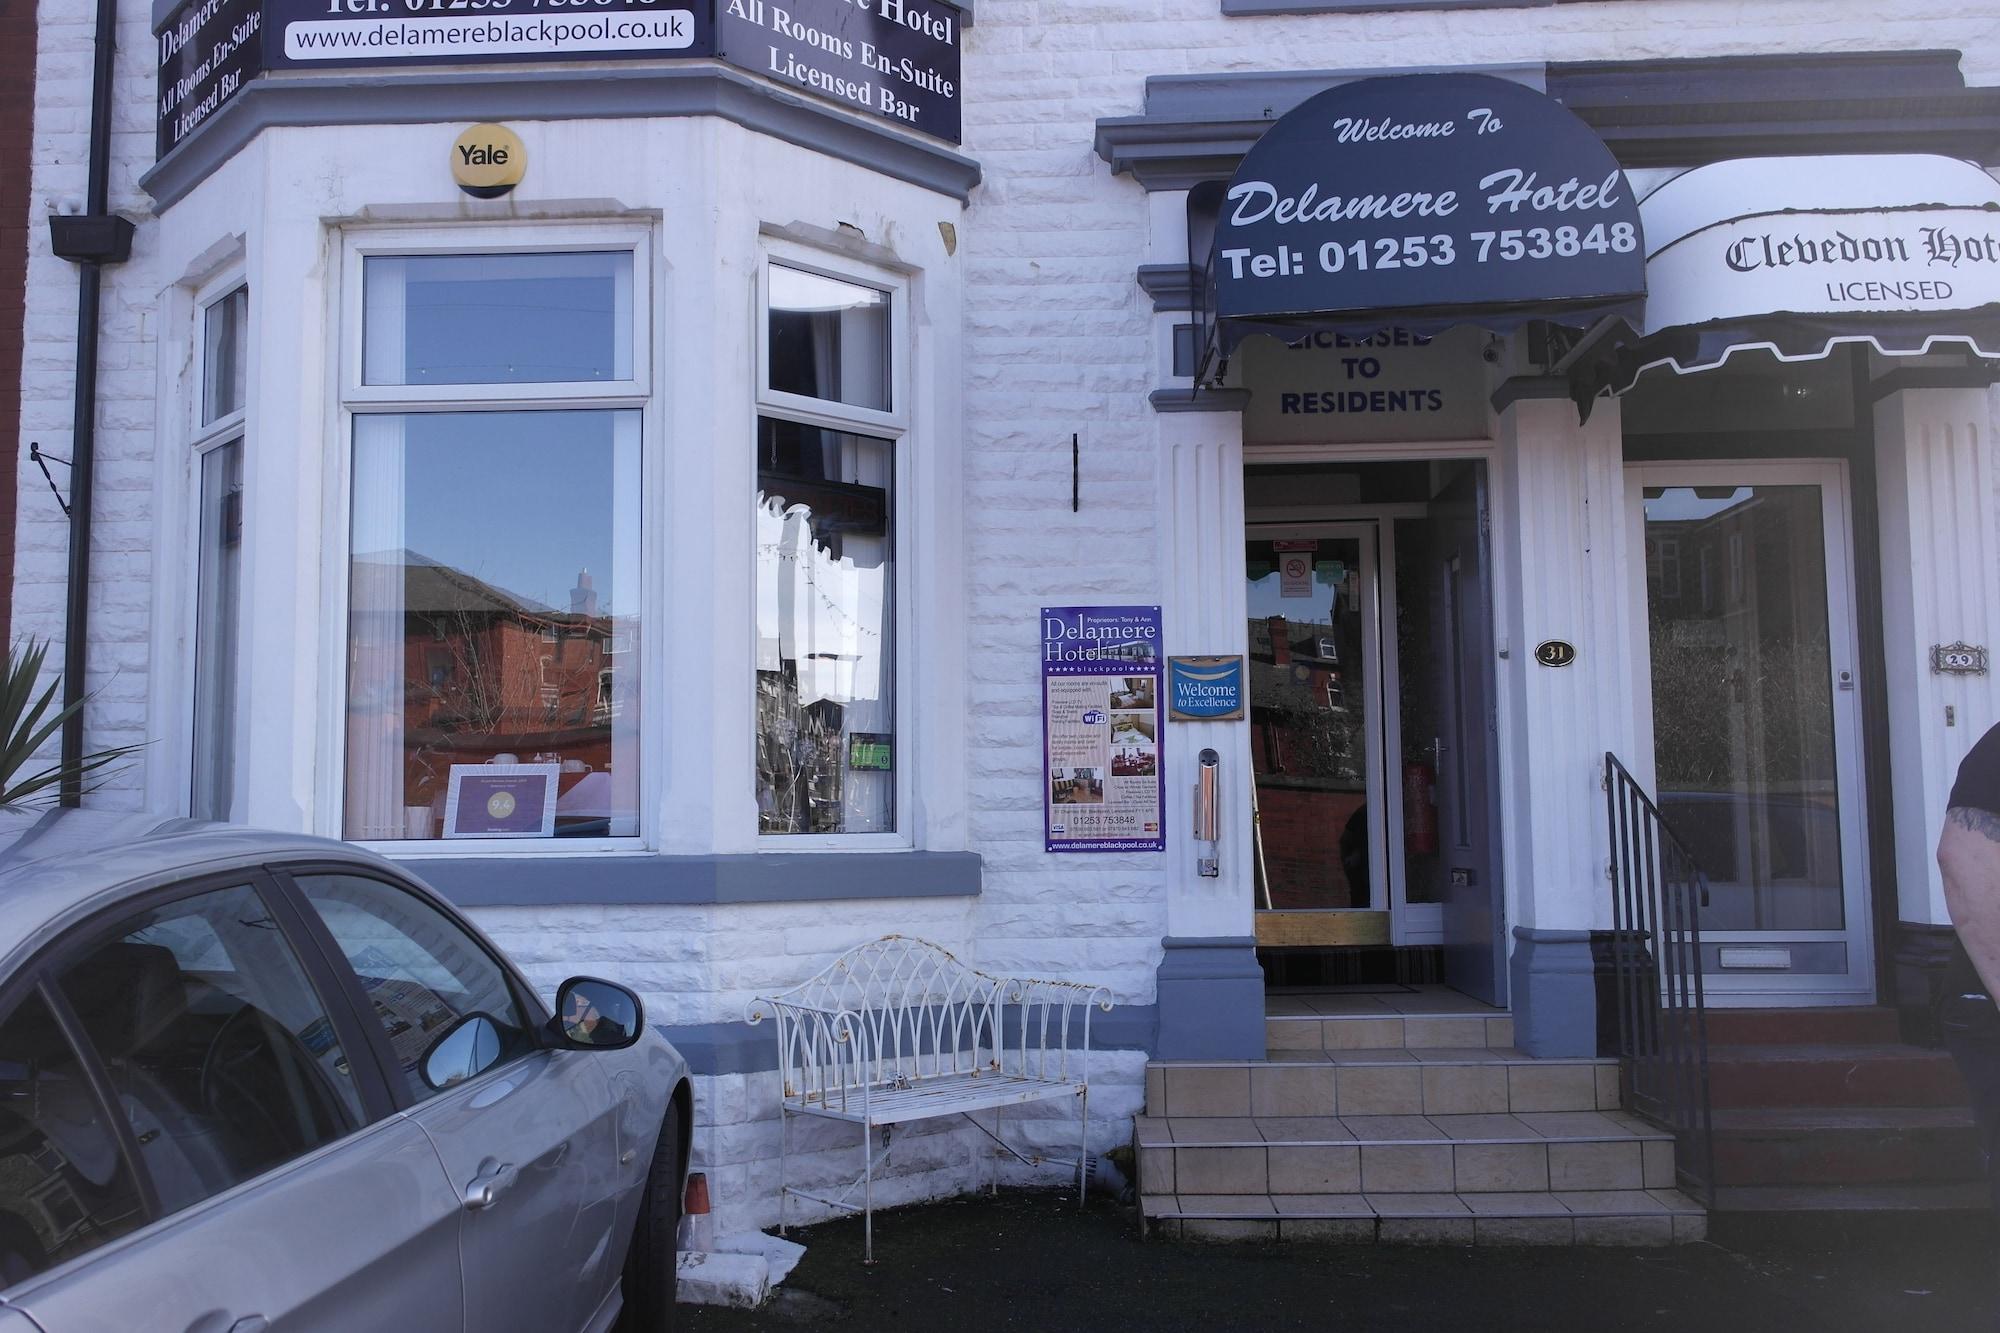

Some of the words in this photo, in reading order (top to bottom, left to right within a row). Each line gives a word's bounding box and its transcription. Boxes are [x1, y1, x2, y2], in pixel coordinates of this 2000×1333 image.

[296, 16, 683, 47] www.delamereblackpool.co.uk
[878, 0, 953, 45] Hotel
[726, 0, 764, 26] All
[772, 6, 853, 60] Rooms
[860, 41, 954, 98] En-Suite
[160, 87, 174, 120] All
[177, 58, 210, 104] Rooms
[212, 11, 260, 70] En-Suite
[768, 45, 871, 106] Licensed
[879, 86, 920, 123] Bar
[174, 83, 218, 143] Licensed
[221, 67, 241, 101] Bar
[1333, 116, 1455, 143] Welcome
[1467, 108, 1503, 135] To
[459, 144, 509, 165] Yale
[1227, 180, 1459, 227] Delamere
[1478, 168, 1620, 214] Hotel
[1221, 245, 1304, 279] Tel:
[1318, 233, 1456, 274] 01253
[1470, 221, 1637, 263] 753848
[1725, 230, 1910, 273] Clevedon
[1919, 226, 2000, 268] Hot
[1826, 280, 1953, 302] LICENSED
[1341, 357, 1380, 379] TO
[1281, 389, 1443, 414] RESIDENTS
[1044, 613, 1156, 640] Delamere
[1120, 616, 1134, 624] Tony
[1044, 638, 1102, 662] Hotel
[1545, 646, 1565, 660] 31
[1950, 655, 1969, 665] 29
[1178, 683, 1236, 697] Welcome
[1178, 698, 1187, 707] to
[1189, 697, 1236, 707] Excellence
[1073, 816, 1101, 825] 01253
[1103, 816, 1136, 824] 753848
[1052, 841, 1157, 850] www.delamereblackpool.co.uk
